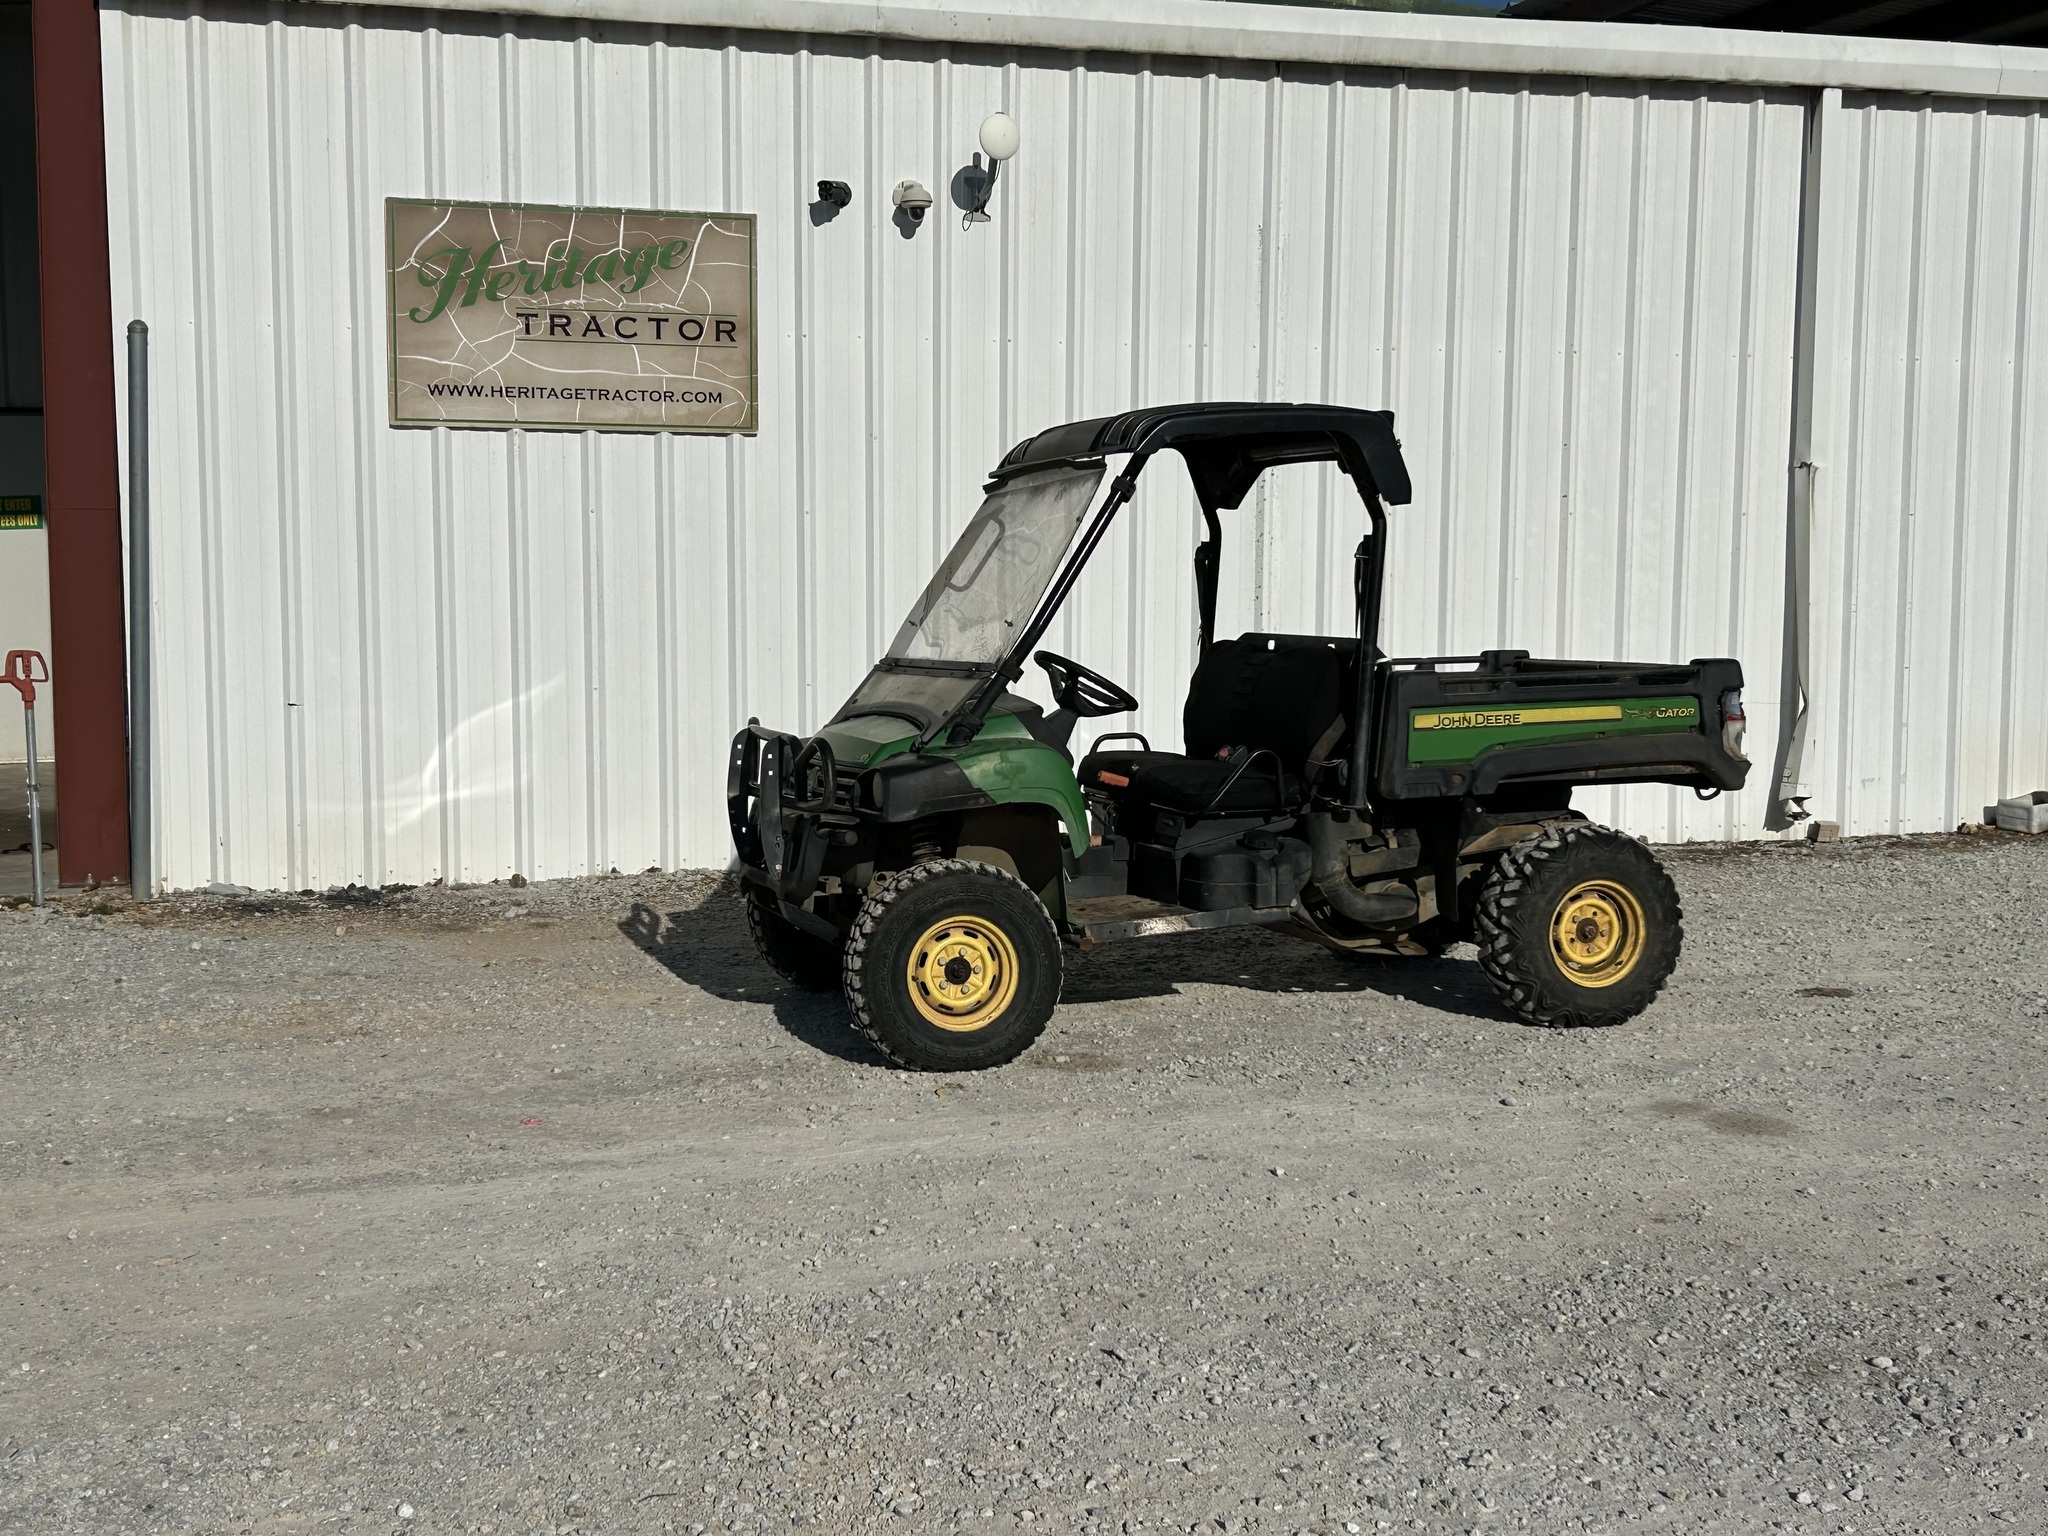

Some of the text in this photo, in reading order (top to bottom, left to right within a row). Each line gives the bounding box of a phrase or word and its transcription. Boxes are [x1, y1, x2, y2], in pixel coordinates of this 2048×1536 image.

[409, 237, 694, 324] Heritage
[515, 312, 738, 343] TRACTOR
[426, 383, 723, 404] WWW.HERITAGETRACTOR.COM
[17, 514, 38, 526] ONLY
[1433, 713, 1522, 729] JOHN DEERE
[1656, 707, 1696, 718] GATOR
